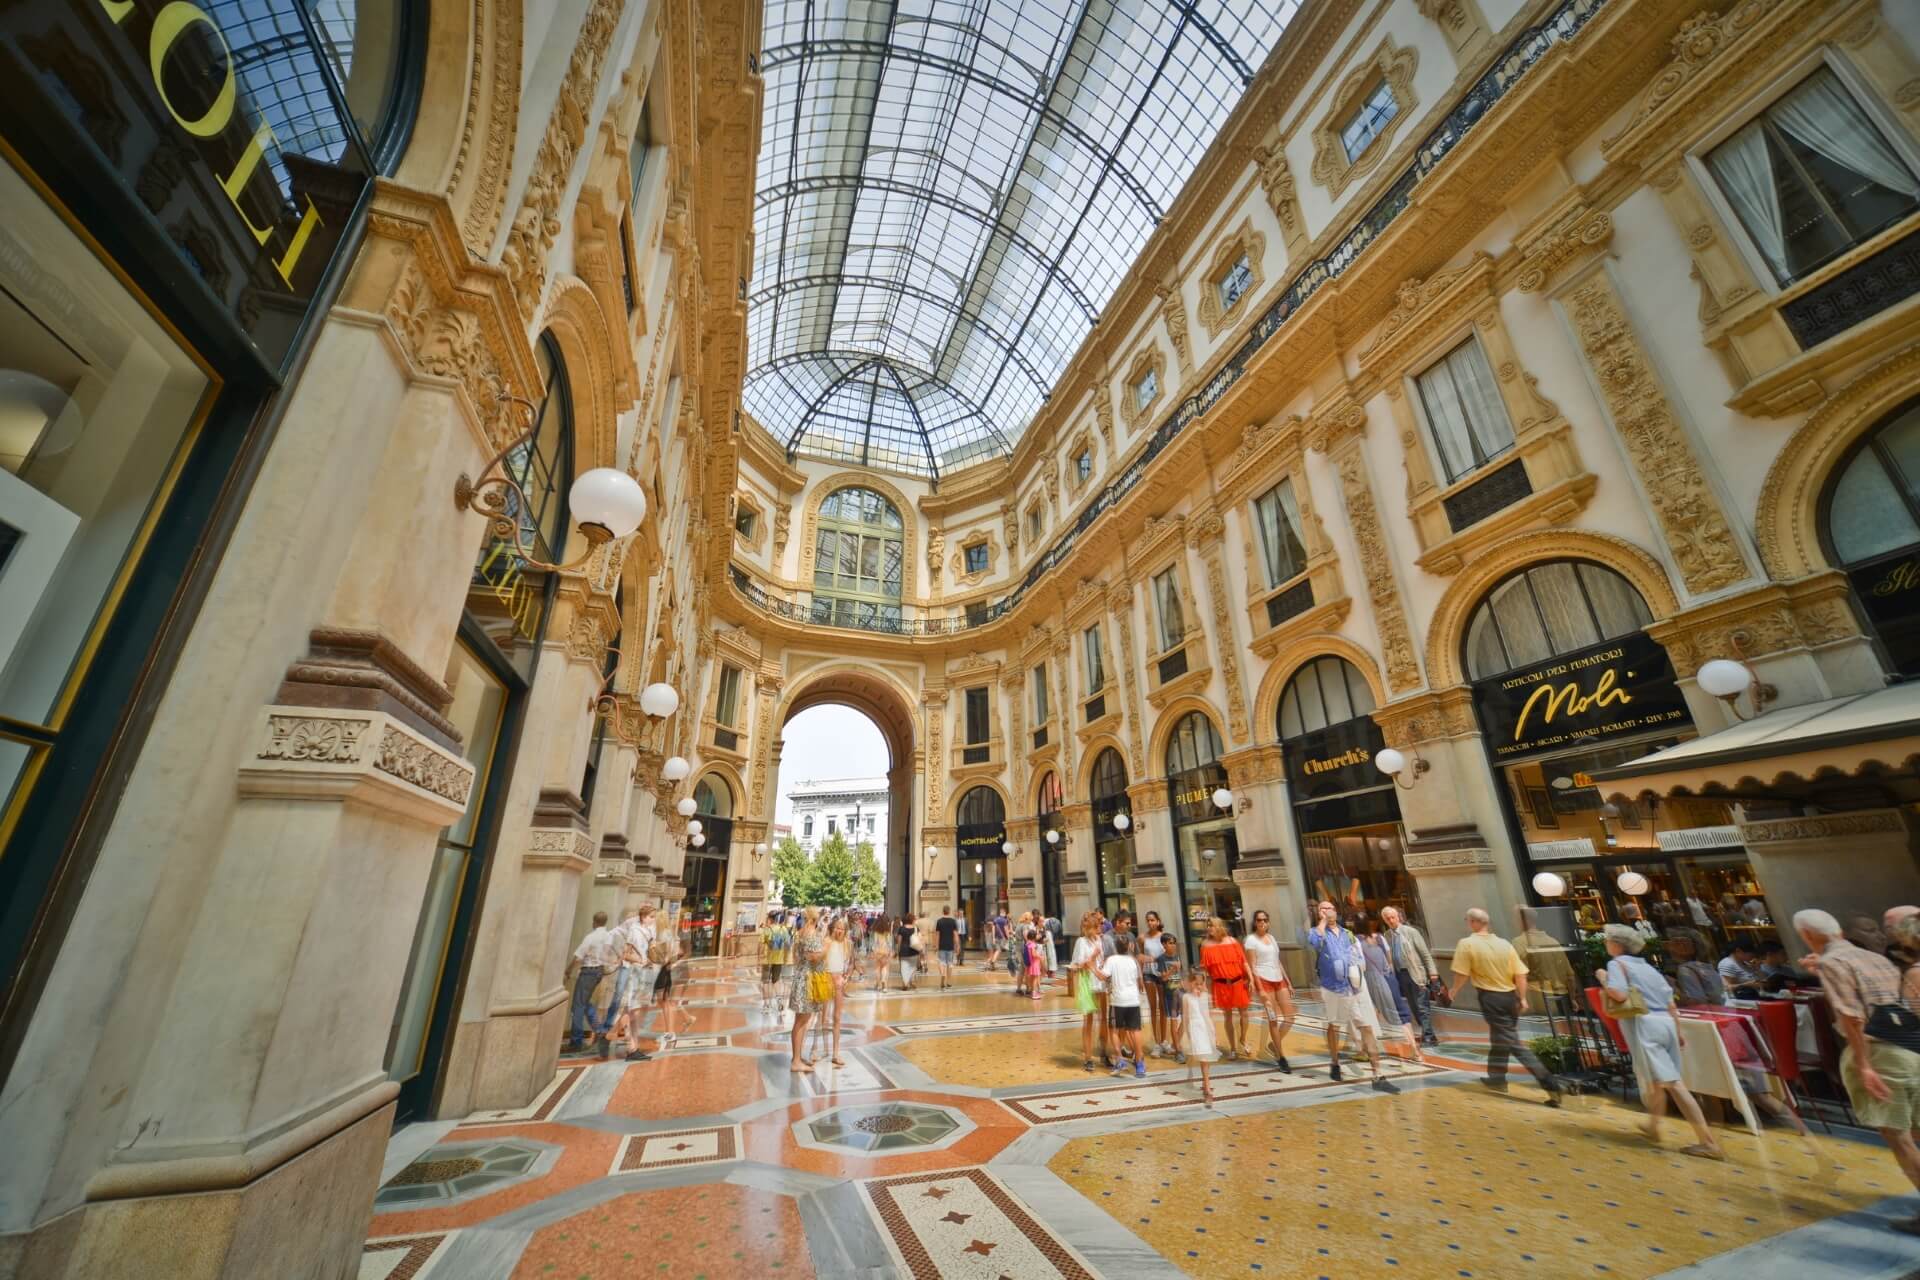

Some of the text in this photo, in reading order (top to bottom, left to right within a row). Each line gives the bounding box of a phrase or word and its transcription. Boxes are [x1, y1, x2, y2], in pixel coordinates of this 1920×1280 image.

[103, 0, 325, 292] OLI
[1502, 647, 1625, 690] ARTICOLI PER FUMATORI
[1602, 719, 1637, 733] BOLLATI
[1303, 746, 1369, 775] Church's
[960, 835, 1000, 846] MONTBLANC
